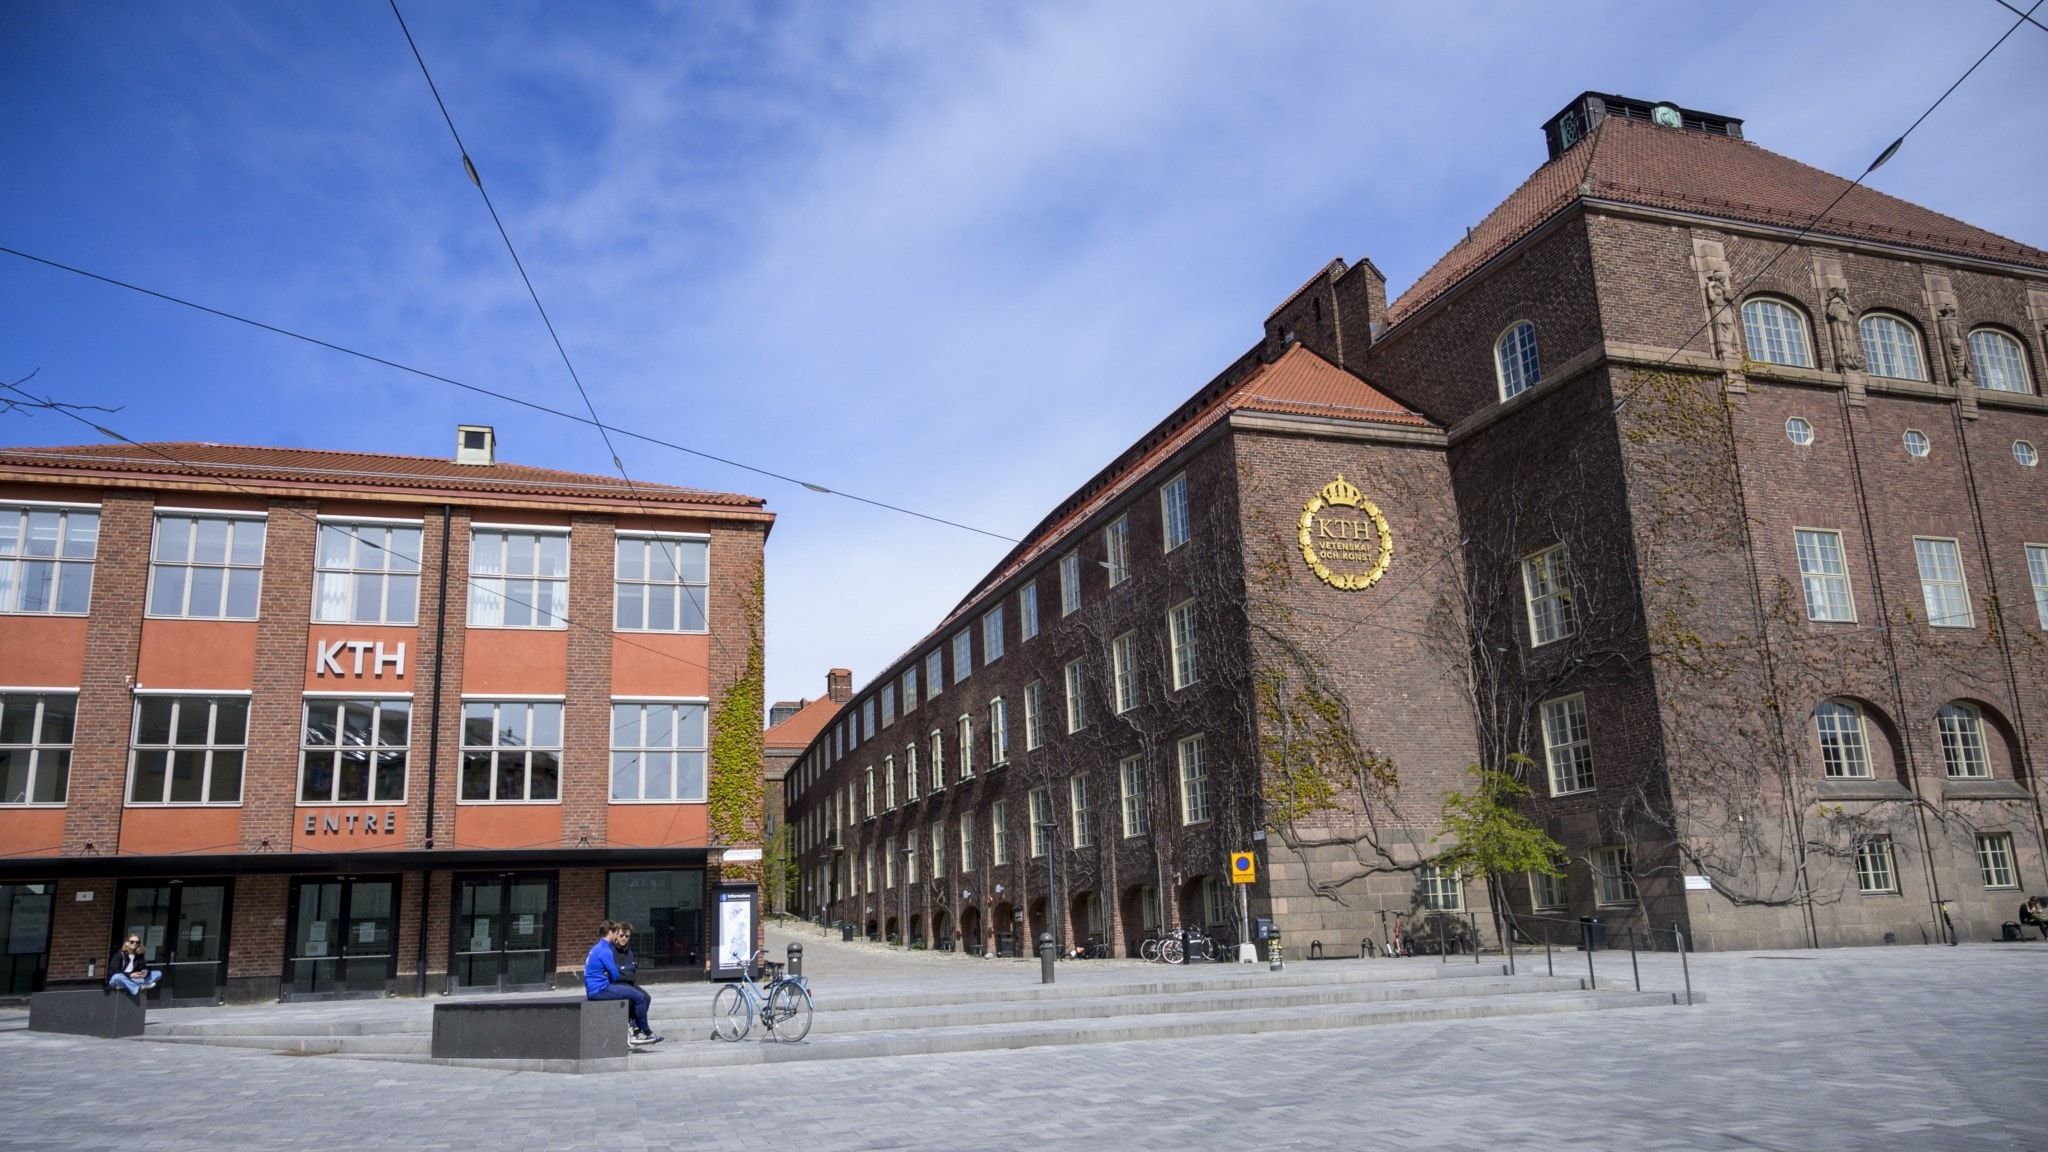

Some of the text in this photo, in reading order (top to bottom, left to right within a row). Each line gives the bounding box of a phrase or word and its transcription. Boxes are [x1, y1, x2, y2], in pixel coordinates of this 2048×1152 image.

[1317, 518, 1371, 540] KTH
[1319, 542, 1372, 552] VETENSKAP
[1320, 551, 1372, 562] OCH KONST
[316, 639, 406, 678] KTH
[304, 811, 396, 835] ENTRÉ
